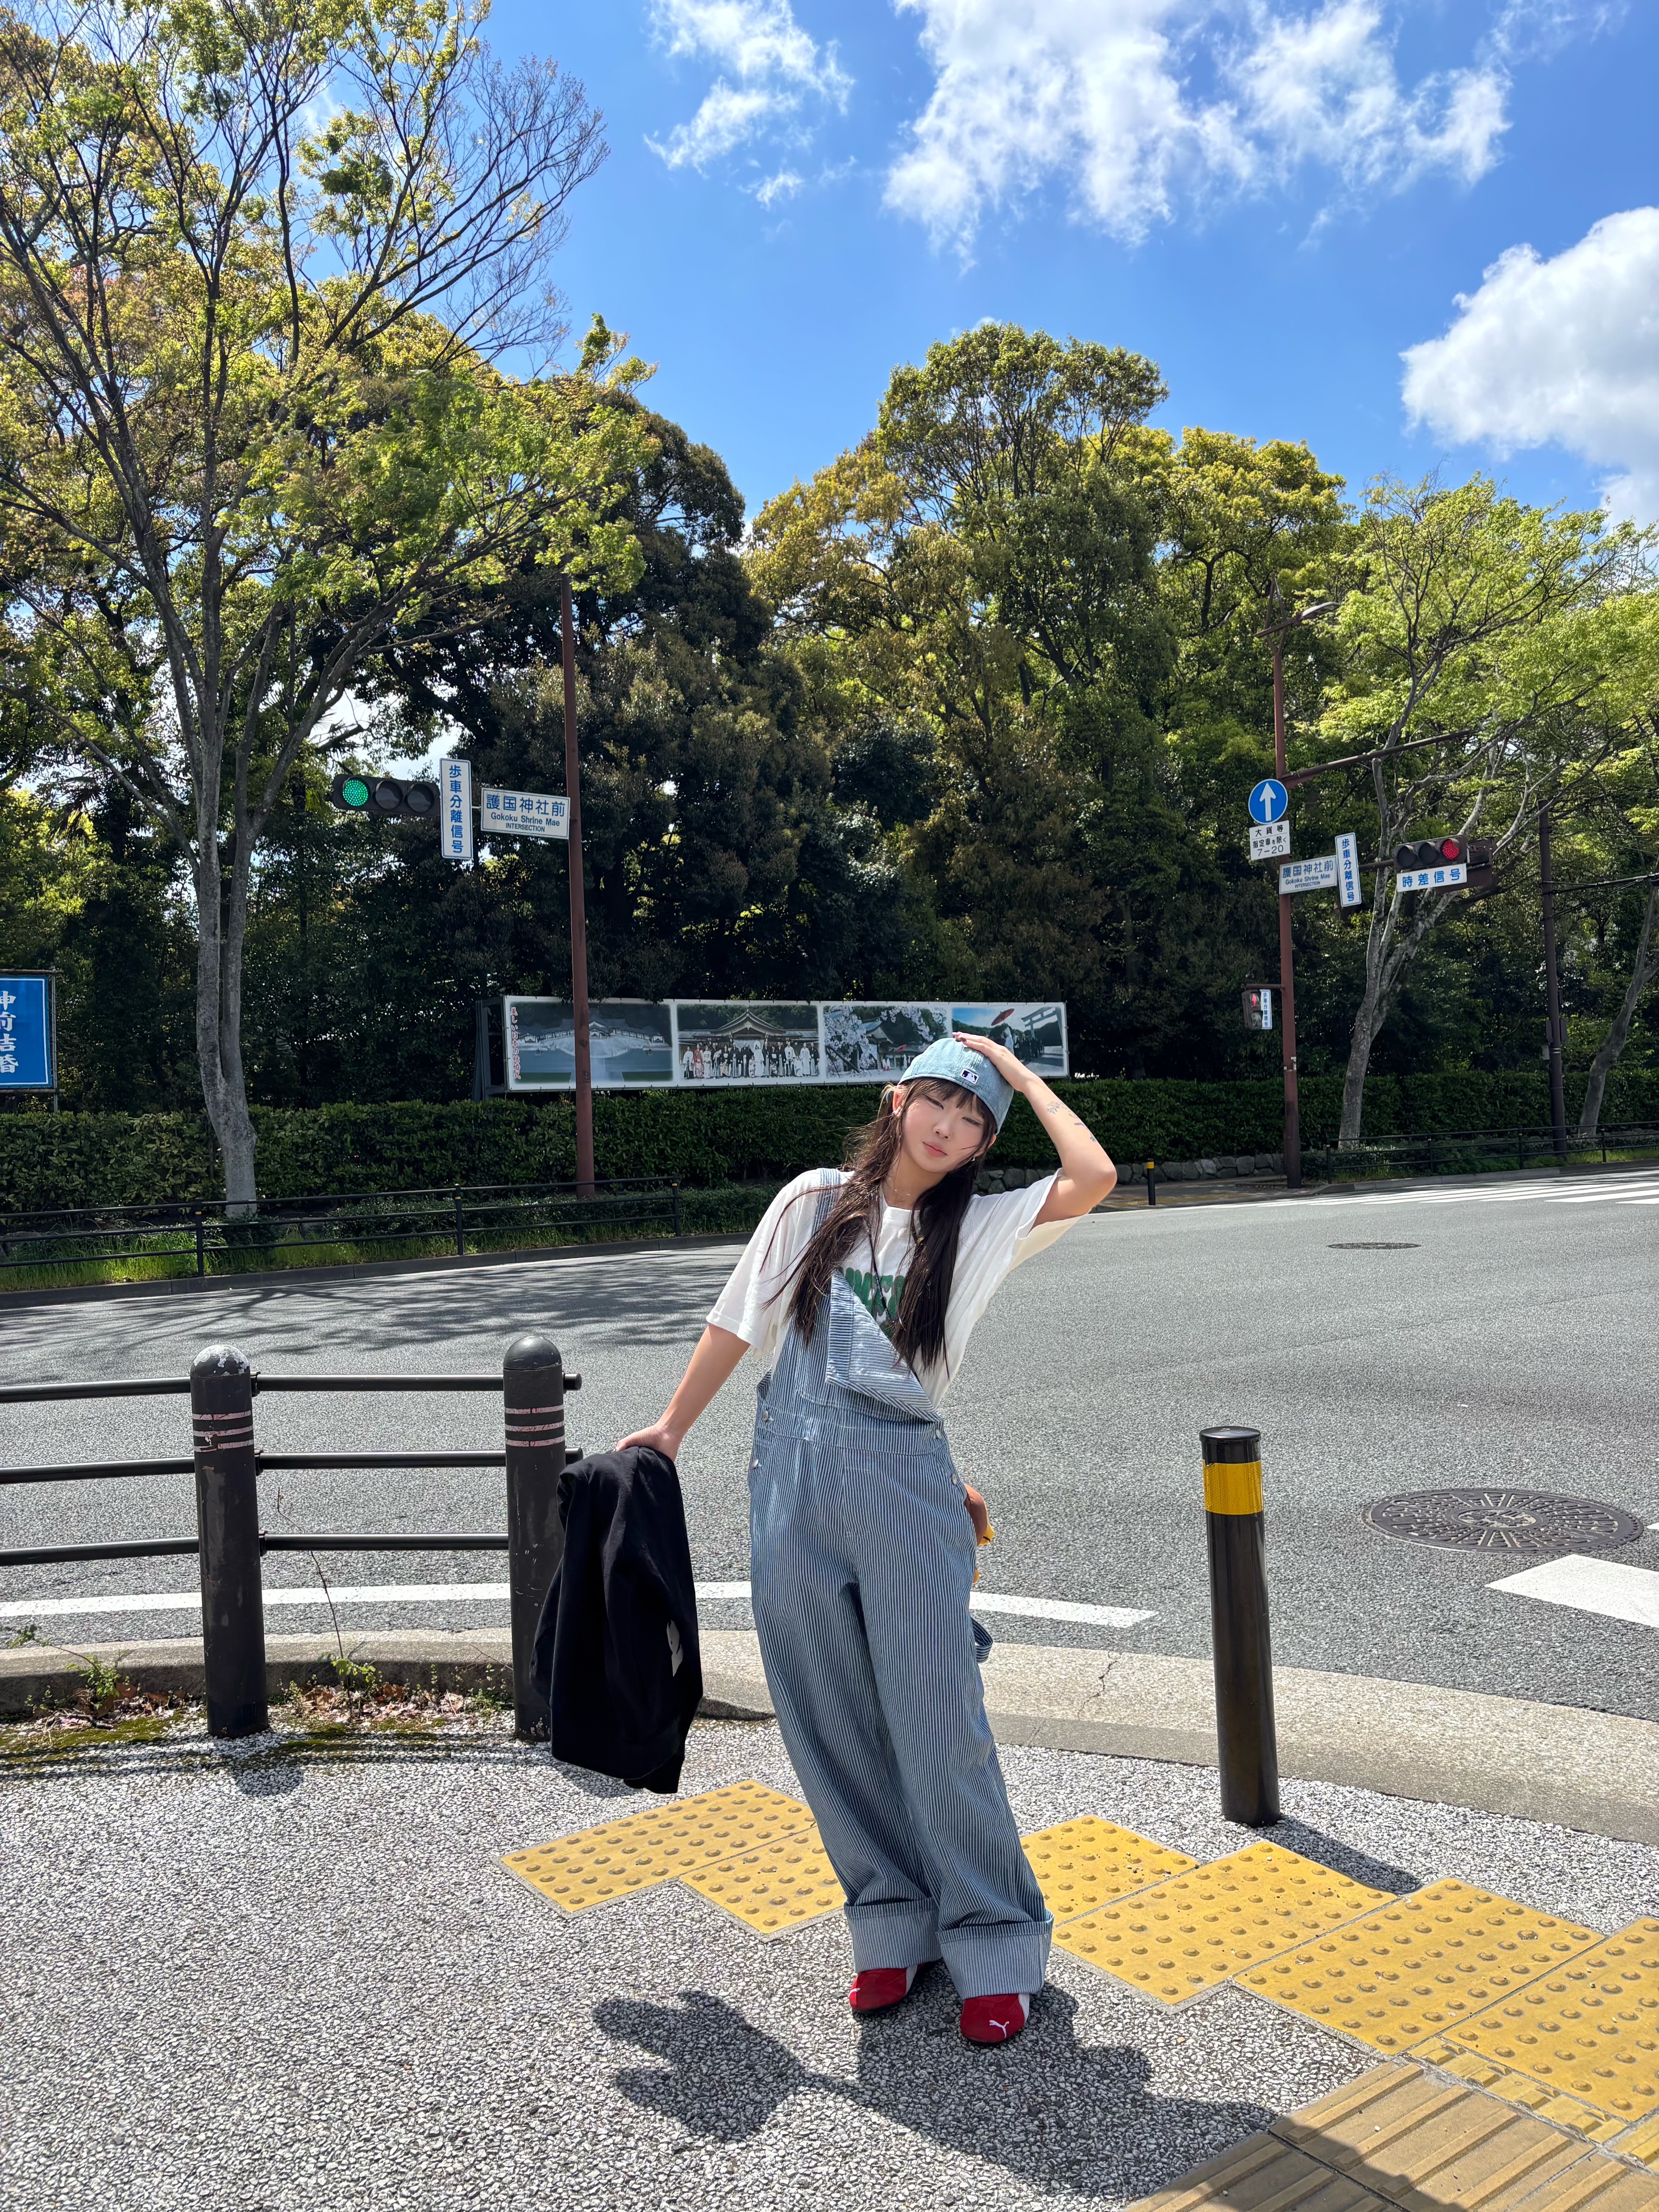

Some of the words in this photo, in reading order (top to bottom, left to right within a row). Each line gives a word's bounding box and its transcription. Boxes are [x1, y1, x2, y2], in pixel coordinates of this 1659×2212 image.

[449, 765, 463, 853] 歩車分離信号
[486, 794, 565, 817] 護国神社前
[491, 812, 518, 822] Gokoku
[521, 815, 543, 824] Shrine
[546, 818, 560, 827] Mae
[506, 822, 545, 832] INTERSECTION
[1255, 825, 1283, 837] 大貨等
[1253, 836, 1286, 848] 指定車を除く
[1283, 860, 1333, 878] 護国神社前
[1341, 838, 1355, 902] 歩車分離信号
[1402, 868, 1460, 887] 時差信号
